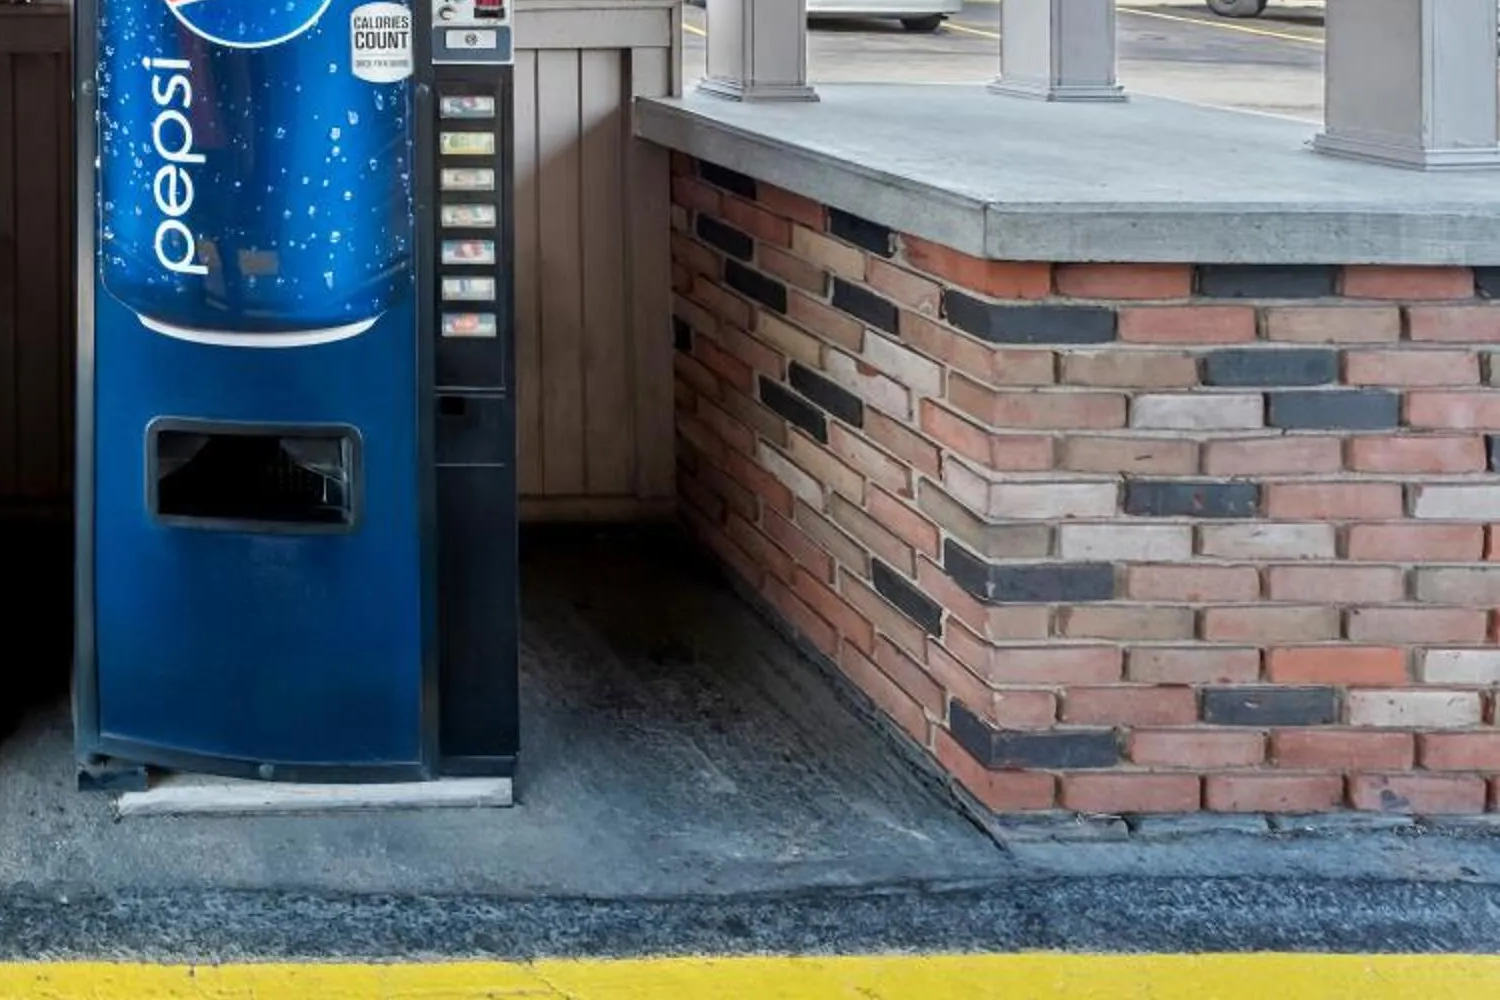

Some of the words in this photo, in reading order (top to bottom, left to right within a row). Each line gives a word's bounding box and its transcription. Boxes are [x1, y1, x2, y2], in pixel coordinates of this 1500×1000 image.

[353, 16, 409, 30] CALORIES
[355, 31, 409, 50] COUNT
[142, 56, 208, 275] pepsi
